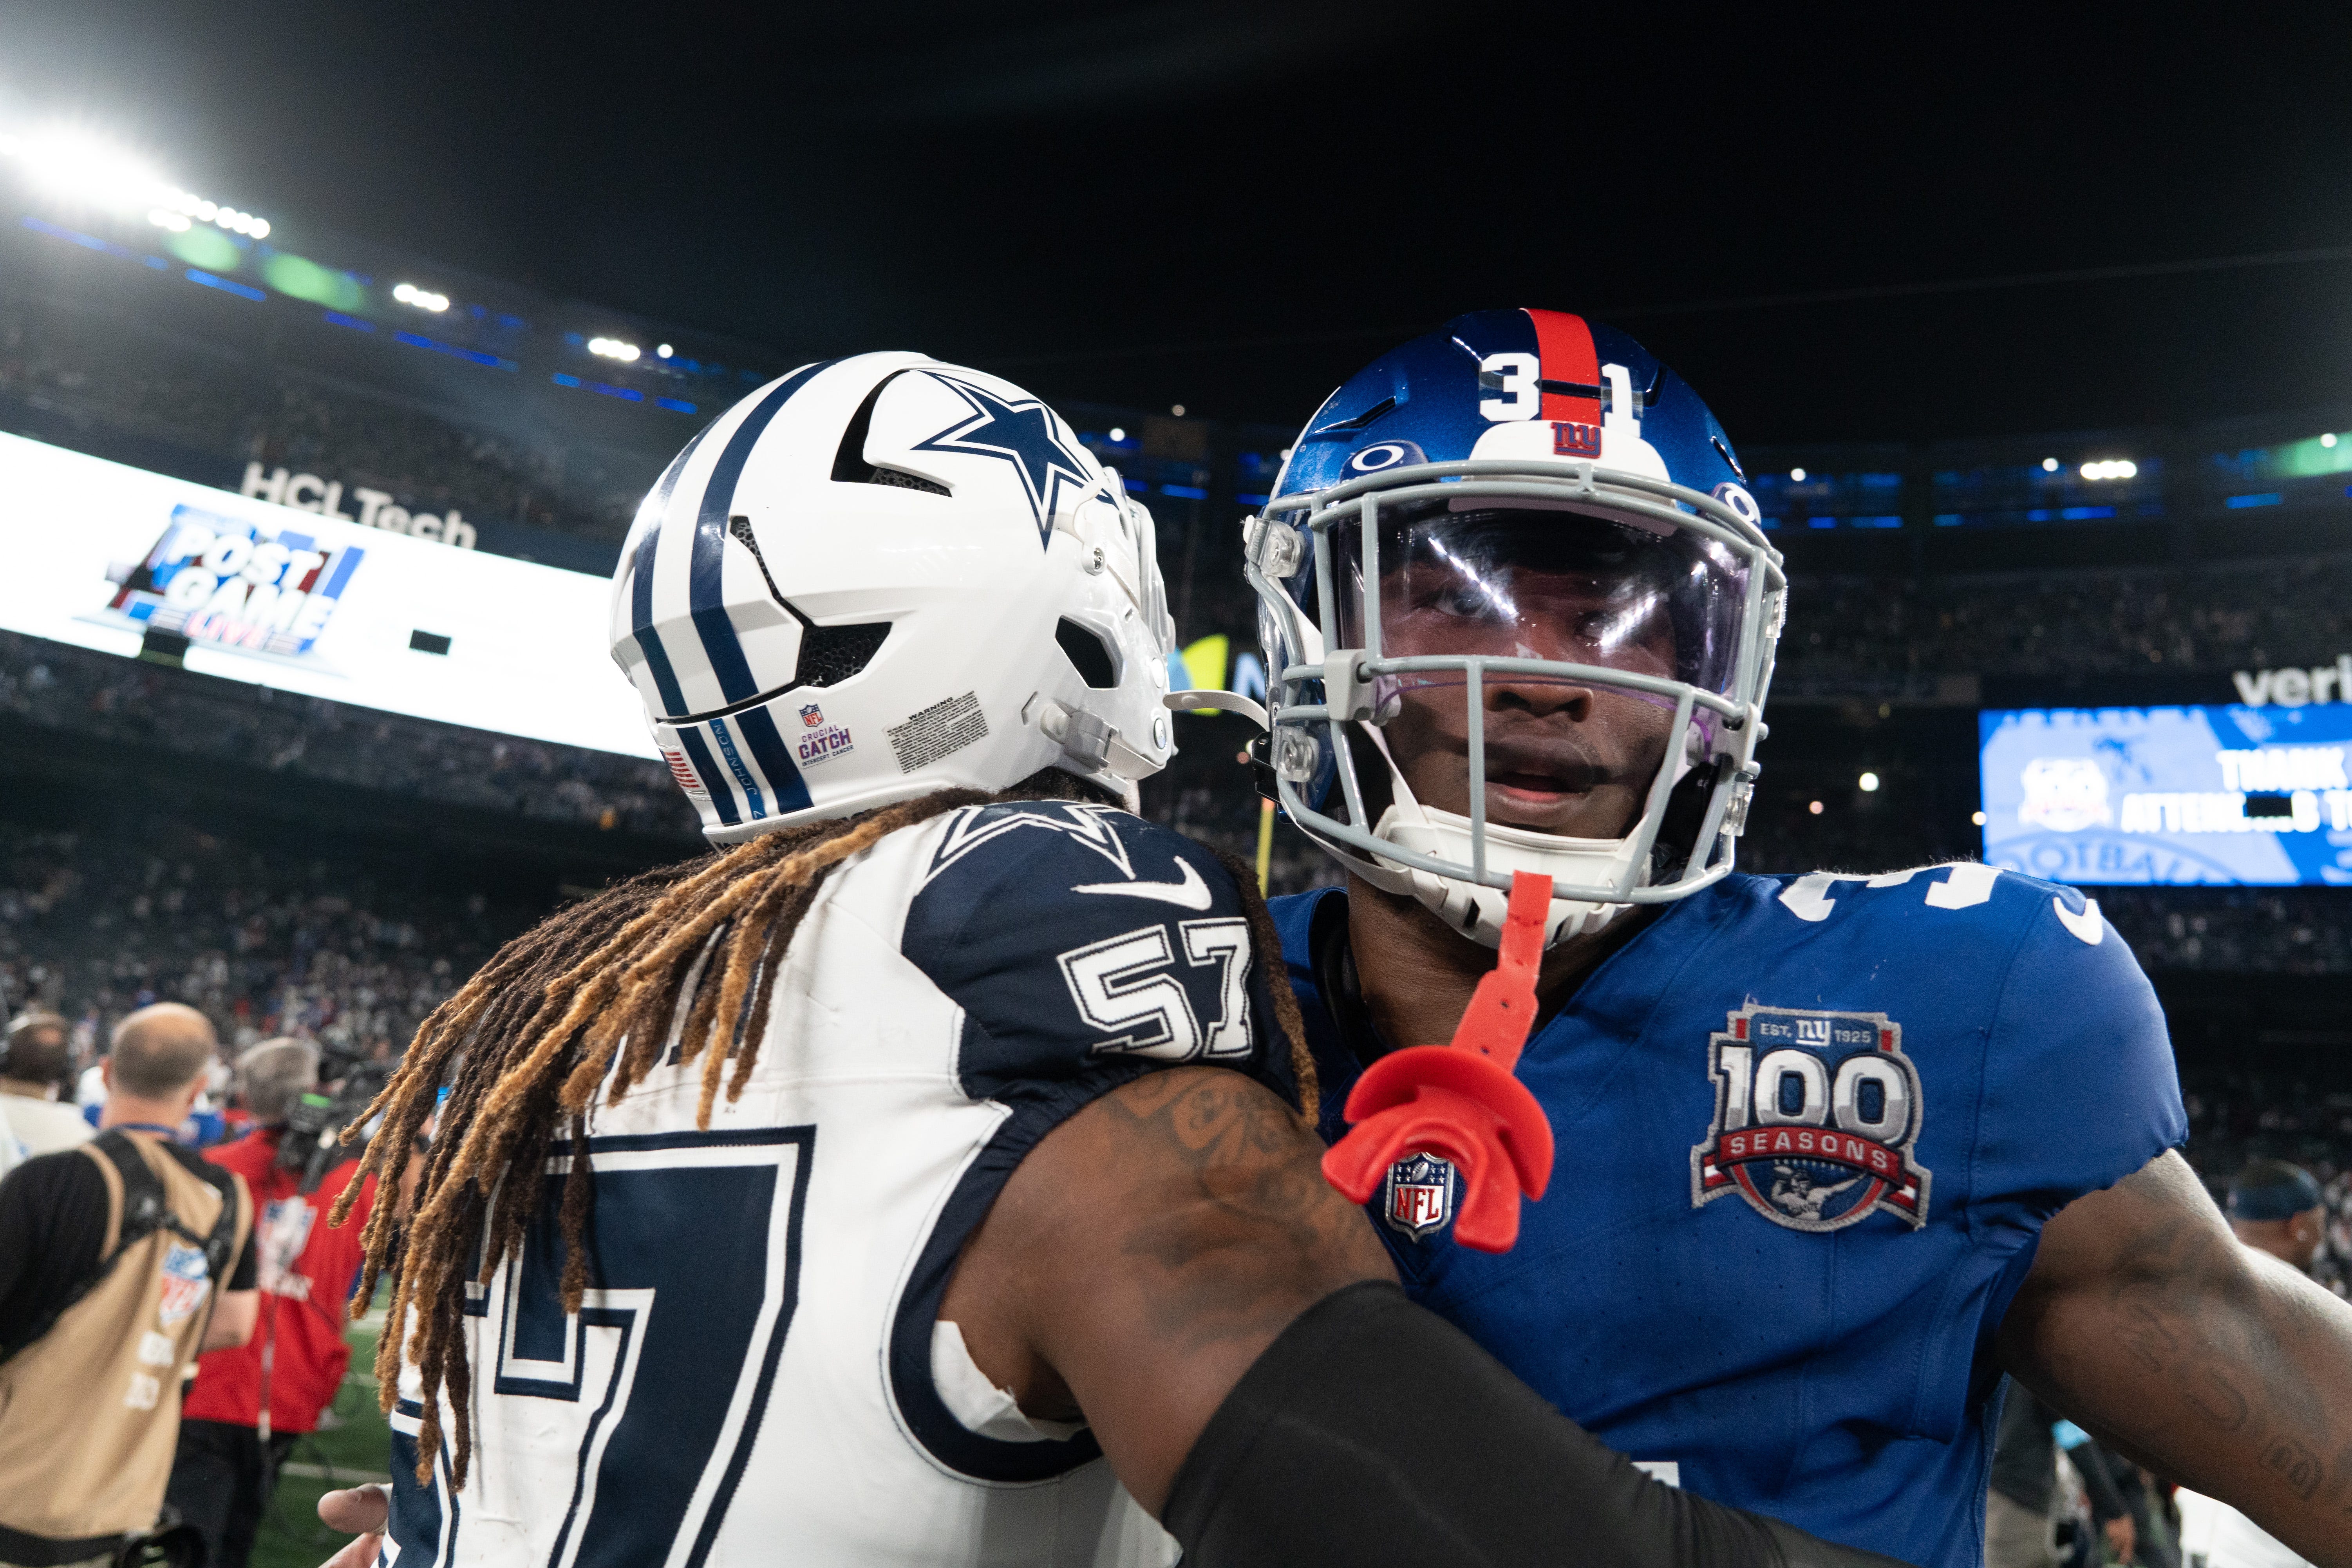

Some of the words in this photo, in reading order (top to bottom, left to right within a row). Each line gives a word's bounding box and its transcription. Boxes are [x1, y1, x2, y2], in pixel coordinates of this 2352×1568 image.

[241, 461, 477, 549] HCLTech
[166, 523, 325, 590] POST
[165, 566, 338, 638] GAME
[804, 713, 823, 725] NFL
[908, 697, 953, 720] WARNING
[798, 728, 851, 759] CATCH
[801, 725, 839, 743] CRUCIAL
[713, 725, 758, 795] JOHNSON
[802, 754, 830, 767] INTERCEPT
[832, 745, 854, 756] CANCER
[1057, 917, 1253, 1062] 57
[1760, 1023, 1791, 1038] EST.
[1835, 1031, 1872, 1043] 1925
[1719, 1045, 1909, 1144] 100
[1730, 1130, 1888, 1170] SEASONS
[1395, 1187, 1439, 1225] NFL
